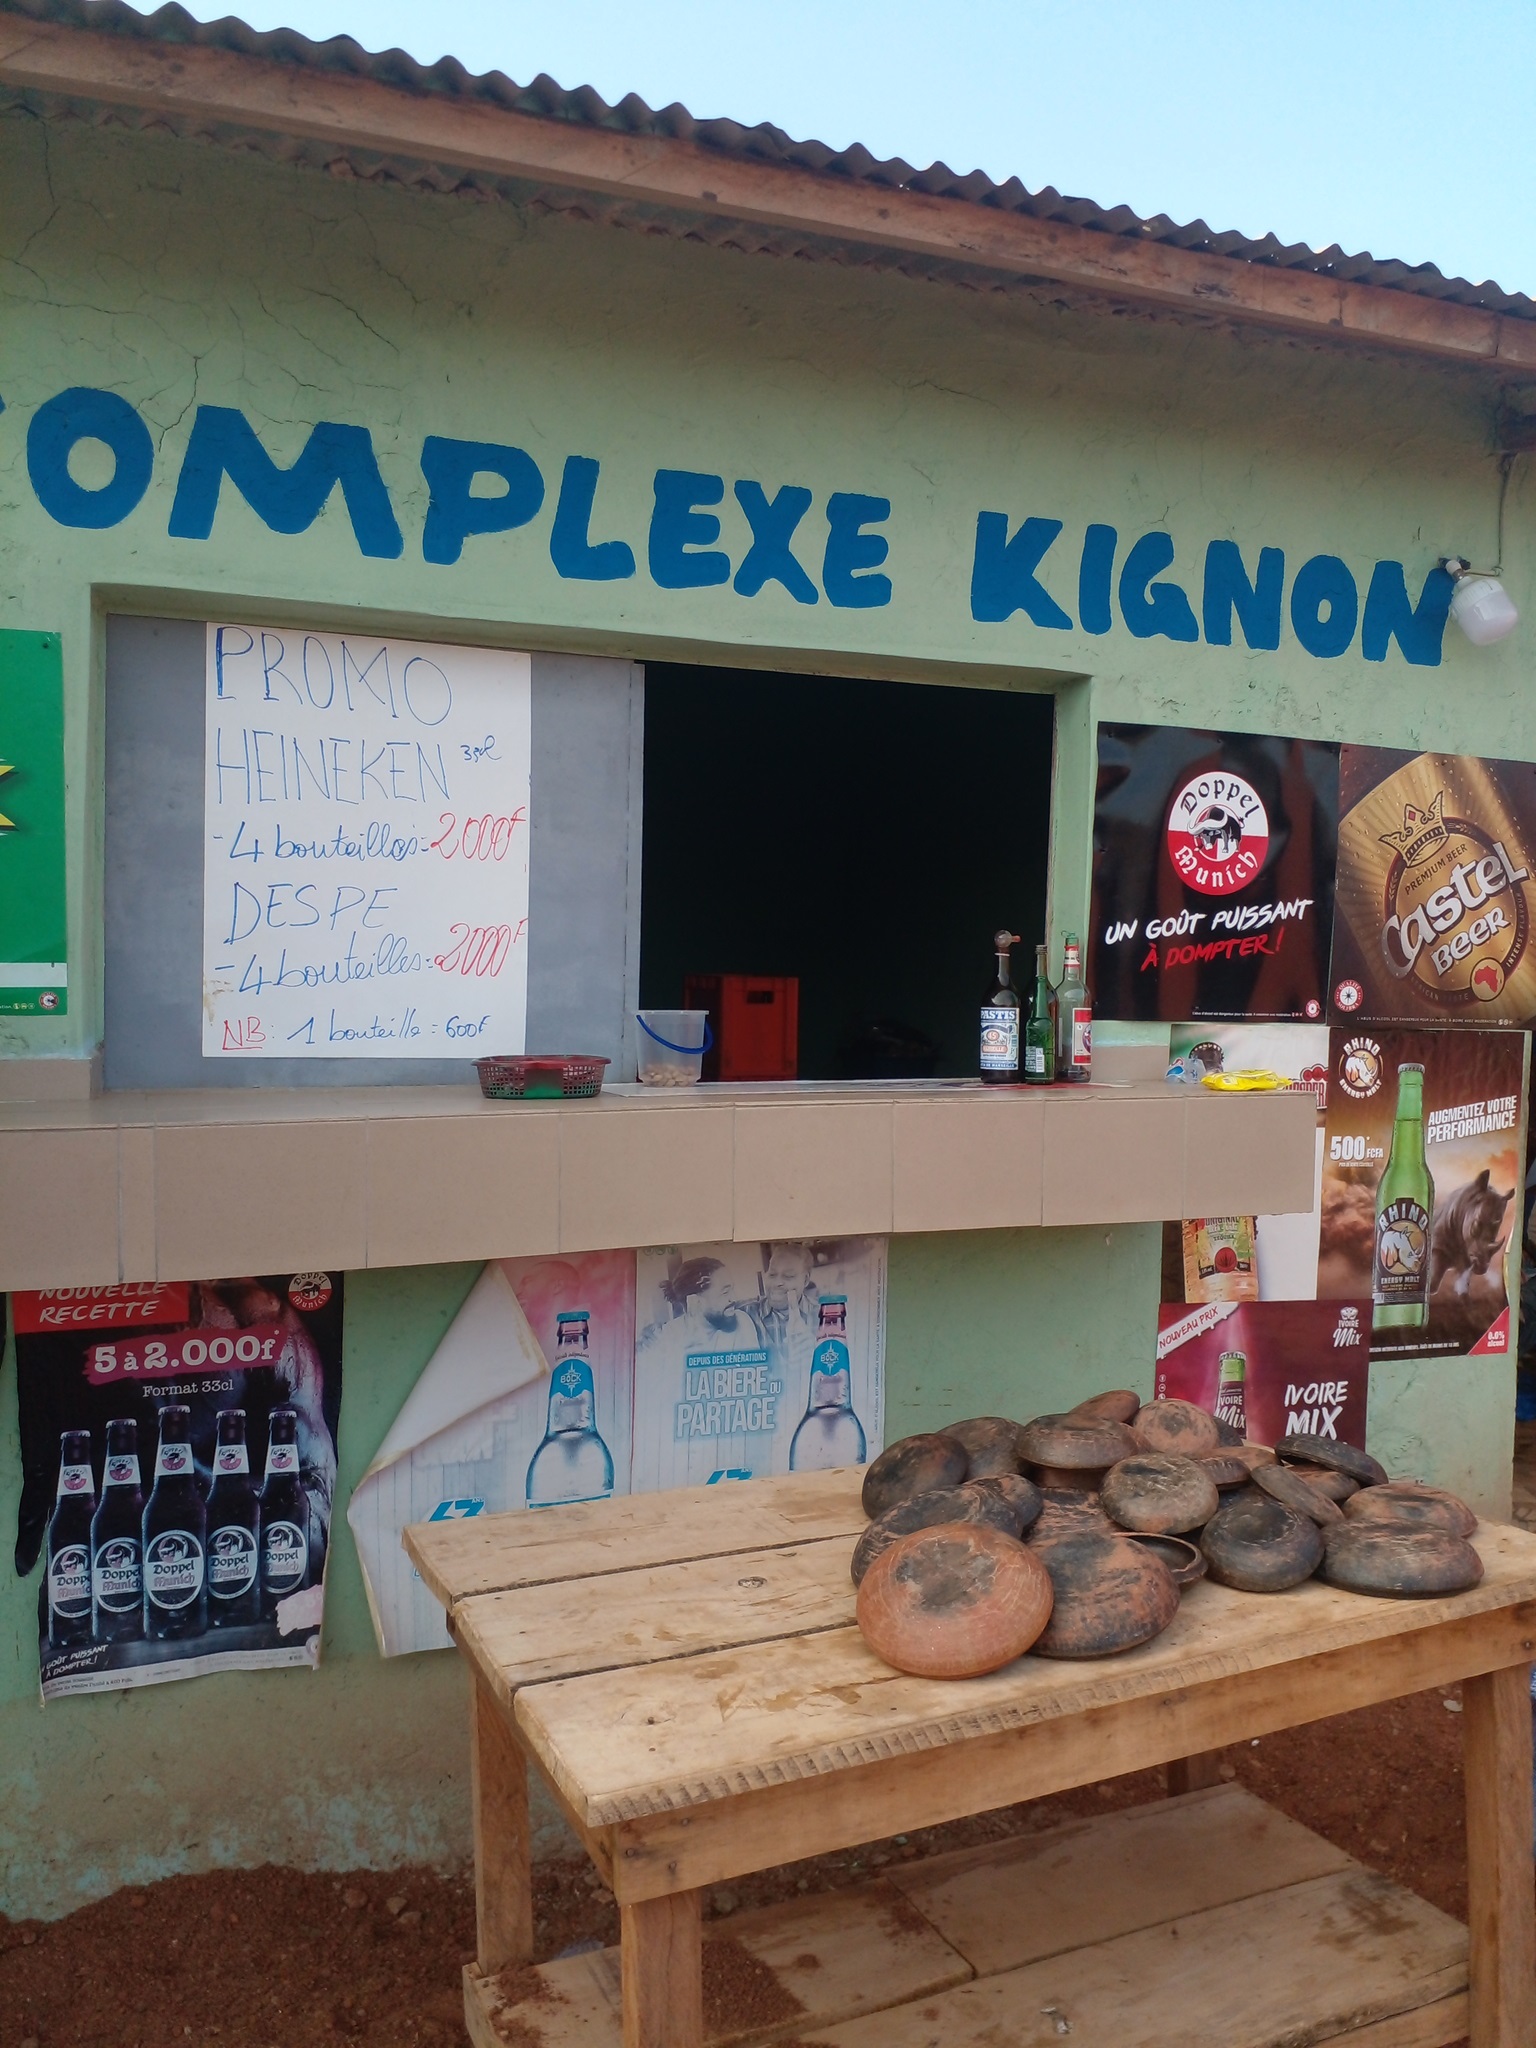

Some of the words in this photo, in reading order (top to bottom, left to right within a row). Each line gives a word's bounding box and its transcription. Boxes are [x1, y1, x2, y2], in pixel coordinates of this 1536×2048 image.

[0, 386, 892, 608] OMPLEXE
[971, 511, 1452, 666] KIGNON
[216, 626, 452, 726] PROMO
[216, 727, 450, 805] HEINEKEN
[1180, 777, 1260, 819] Doppel
[1175, 845, 1259, 888] Munich
[1404, 859, 1446, 895] PREMIUM
[1447, 843, 1468, 863] BEER
[1105, 918, 1138, 945] UN
[1145, 909, 1207, 940] GOÛT
[1211, 897, 1315, 931] PUISSANT
[1140, 942, 1159, 972] À
[1506, 933, 1524, 967] INTENSE
[287, 1017, 315, 1044] 1
[330, 1008, 421, 1041] bouteille
[1343, 1037, 1380, 1056] RHINO
[1428, 1102, 1485, 1126] AUGMENTEZ
[1487, 1095, 1518, 1114] VOTRE
[1427, 1110, 1516, 1144] PERFORMANCE
[1366, 1148, 1384, 1158] FCFA
[1379, 1203, 1428, 1232] RHINO
[294, 1272, 327, 1286] Doppel
[40, 1300, 160, 1325] RECETTE
[293, 1294, 327, 1309] Munich
[1159, 1318, 1198, 1349] NOUVEAU
[1199, 1306, 1218, 1325] PRIX
[1333, 1327, 1363, 1347] Mix
[1338, 1319, 1359, 1328] IVOIRE
[94, 1346, 117, 1373] 5
[123, 1351, 139, 1371] à
[688, 1356, 711, 1367] DEPUIS
[712, 1356, 724, 1365] DES
[725, 1352, 767, 1365] GÉNÉRATIONS
[142, 1381, 198, 1397] Format
[201, 1379, 234, 1393] 33cl
[560, 1374, 582, 1384] BOCK
[686, 1370, 711, 1400] LA
[713, 1363, 768, 1399] BIÈRE
[1284, 1381, 1348, 1407] IVOIRE
[677, 1397, 776, 1437] PARTAGE
[1285, 1406, 1343, 1440] MIX
[154, 1562, 194, 1575] Doppel
[211, 1553, 249, 1567] Doppel
[213, 1565, 249, 1579] Munich
[154, 1573, 195, 1587] Munich
[45, 1655, 68, 1670] GOÛT
[70, 1644, 109, 1660] PUISSANT
